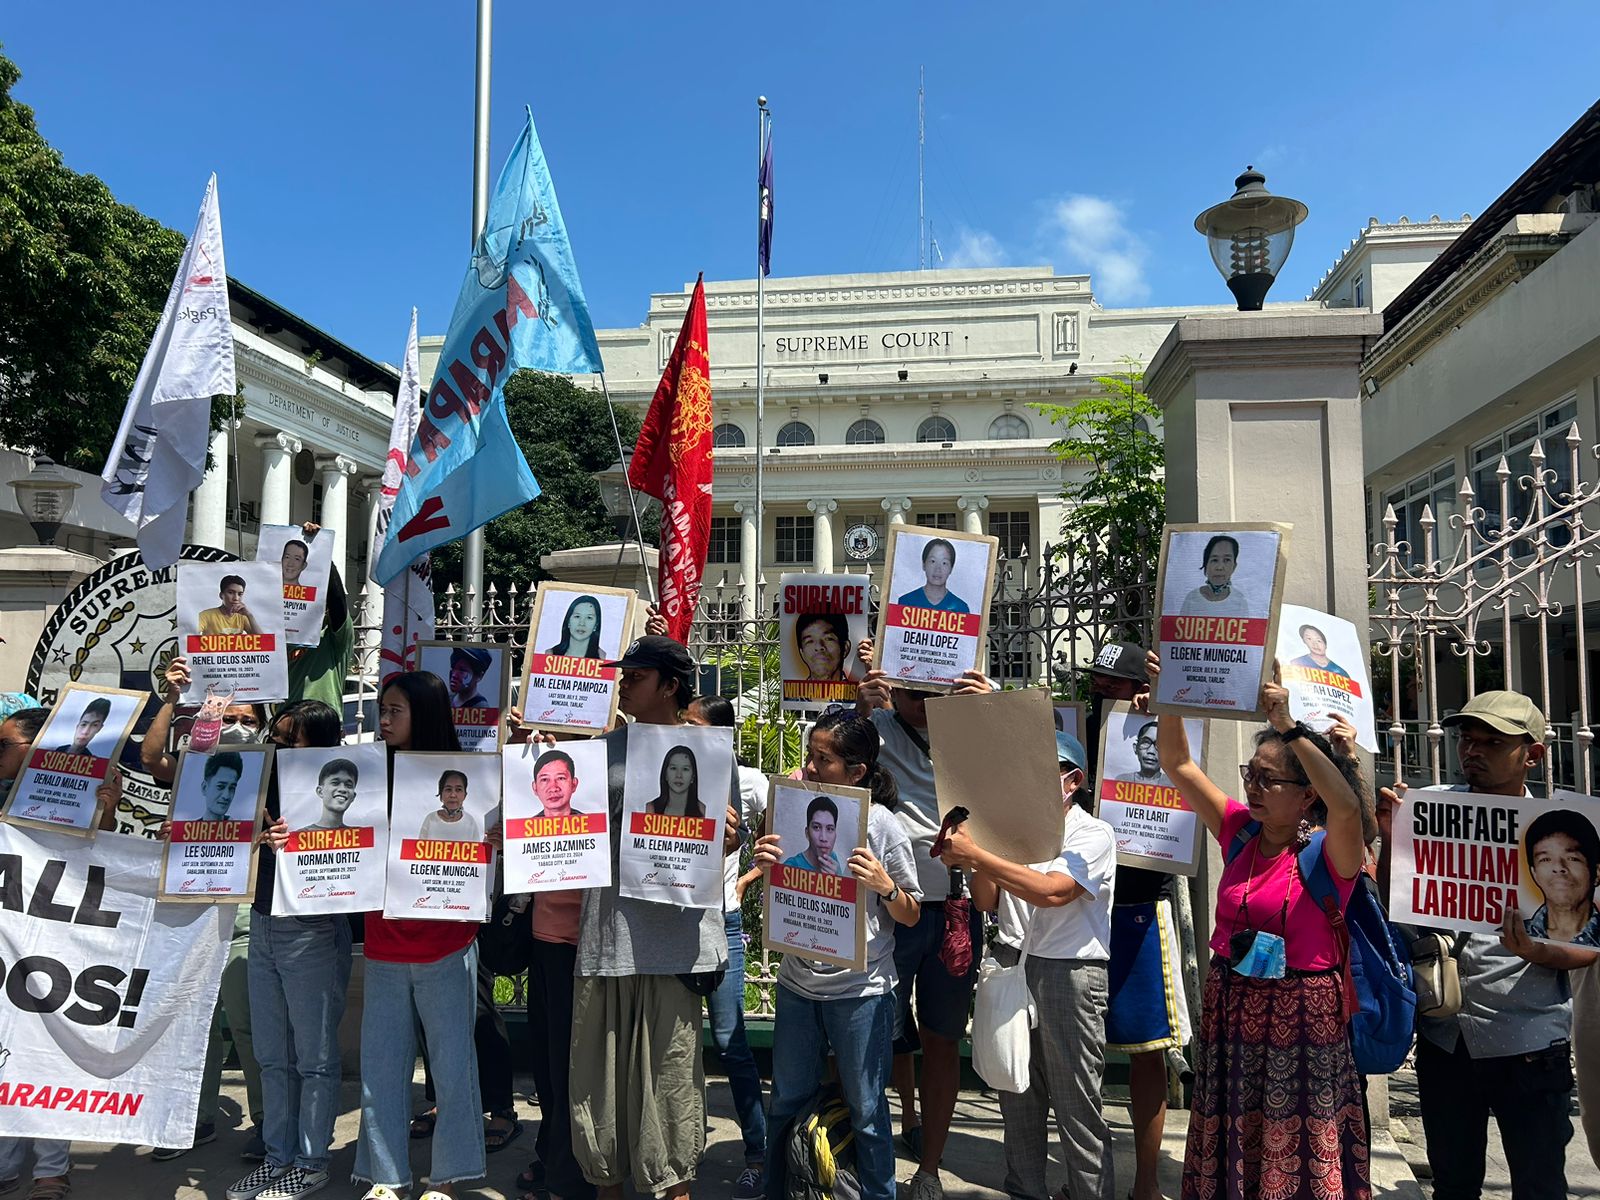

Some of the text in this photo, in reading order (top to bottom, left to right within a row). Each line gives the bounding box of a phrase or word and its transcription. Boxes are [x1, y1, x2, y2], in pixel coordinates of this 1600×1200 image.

[776, 332, 953, 353] SUPREME COURT
[269, 393, 359, 441] DEPARTMENT OF JUSTICE
[70, 565, 177, 635] SUPREM
[784, 585, 864, 615] SURFACE
[901, 606, 966, 632] SURFACE
[1175, 617, 1248, 642] SURFACE
[200, 635, 261, 651] SURFACE
[904, 631, 959, 649] DEAH LOPEZ
[192, 654, 270, 665] RENEL DELOS SANTOS
[1171, 646, 1248, 663] ELGENE MUNGCAL
[544, 656, 604, 678] SURFACE
[533, 677, 608, 694] MA. ELENA PAMPOZA
[784, 682, 821, 699] WILLIAM
[1327, 687, 1351, 704] LOPEZ
[40, 751, 96, 775] SURFACE
[34, 773, 90, 791] DENALD MIALEN
[127, 782, 160, 800] BATAS
[1115, 782, 1182, 808] SURFACE
[1125, 806, 1170, 823] IVER LARIT
[1413, 801, 1519, 845] SURFACE
[182, 822, 241, 840] SURFACE
[524, 816, 589, 836] SURFACE
[643, 814, 704, 838] SURFACE
[298, 829, 360, 850] SURFACE
[522, 838, 596, 854] JAMES JAZMINES
[633, 838, 708, 856] MA. ELENA PAMPOZA
[184, 846, 234, 857] LEE SUDARIO
[297, 852, 360, 866] NORMAN ORTIZ
[415, 841, 478, 861] SURFACE
[410, 864, 479, 877] ELGENE MUNGCAL
[1413, 838, 1518, 885] WILLIAM
[782, 866, 842, 898] SURFACE
[774, 891, 850, 919] RENEL DELOS SANTOS
[1412, 877, 1519, 925] LARIOSA
[0, 954, 150, 1029] OS!
